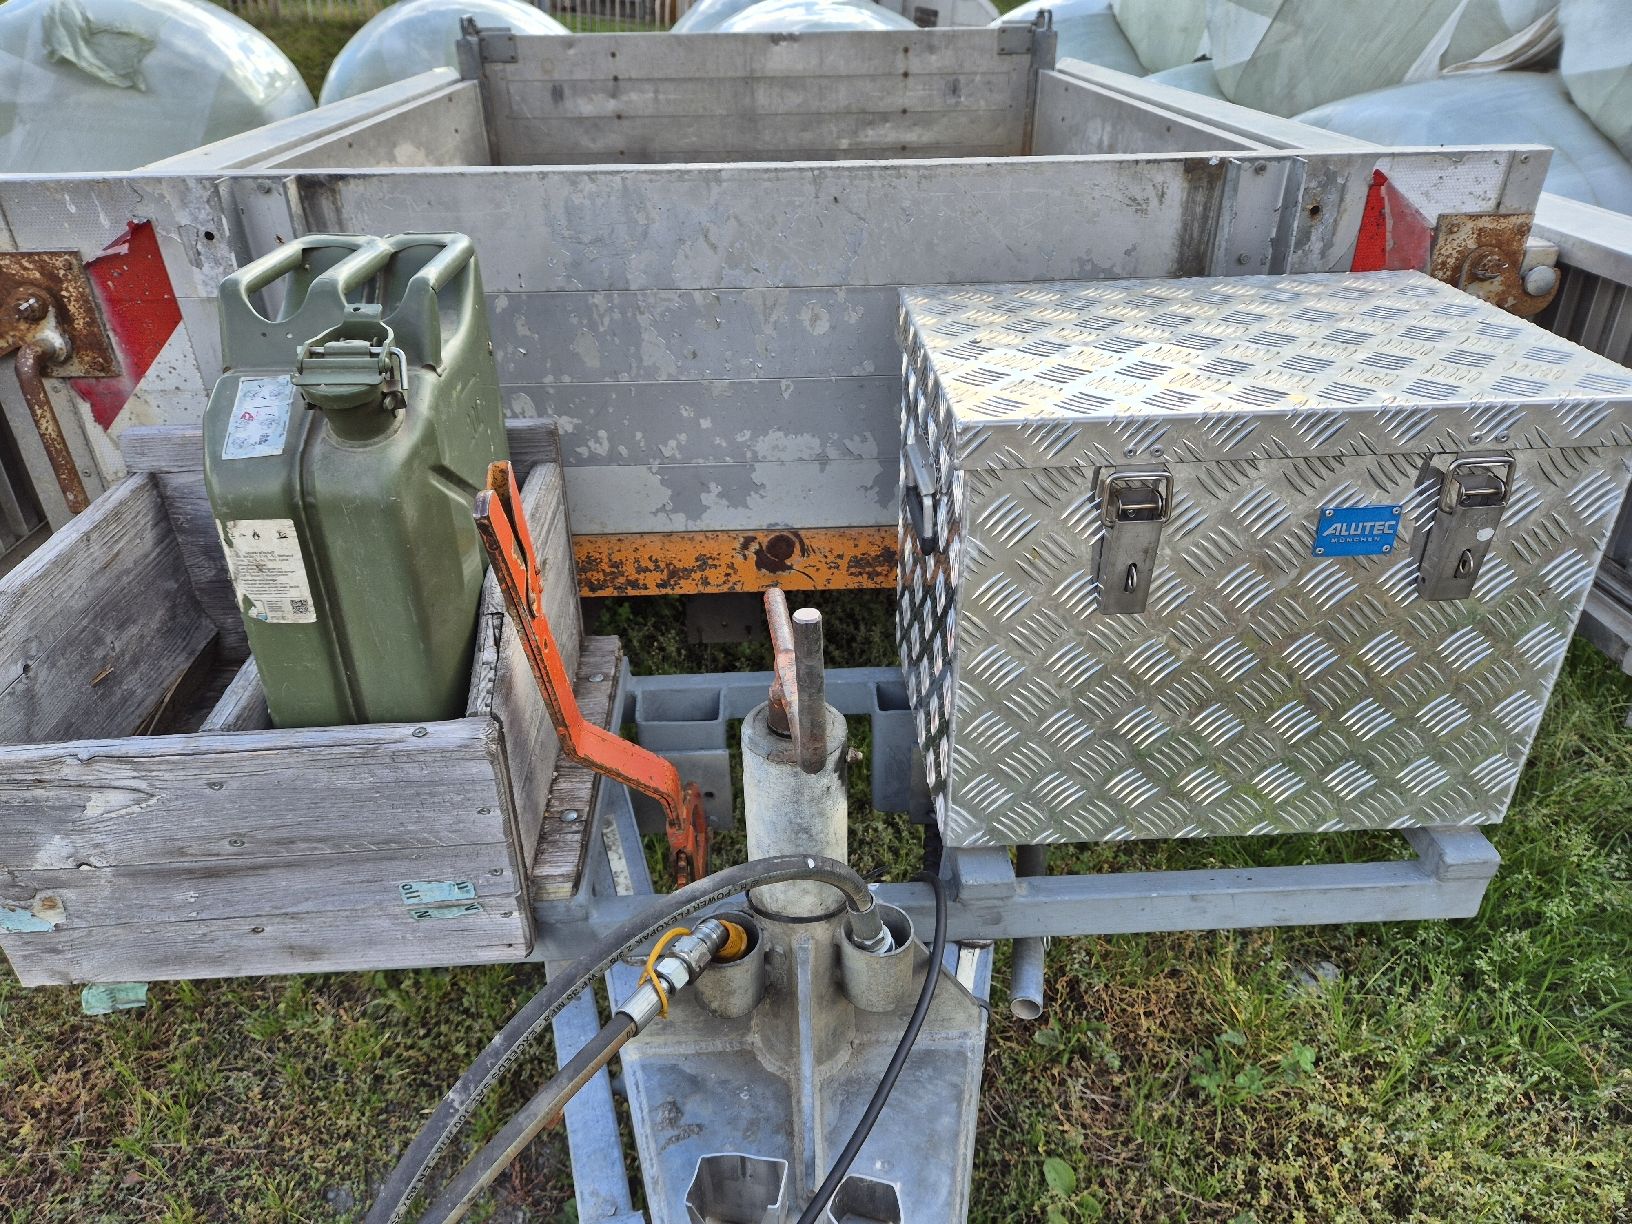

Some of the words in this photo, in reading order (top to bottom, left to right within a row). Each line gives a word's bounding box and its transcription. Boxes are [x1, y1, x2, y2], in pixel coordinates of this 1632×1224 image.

[1322, 520, 1397, 537] ALUTEC
[693, 891, 731, 911] POWER
[635, 908, 691, 945] FLEXOPAK
[581, 973, 598, 990] WP
[566, 988, 580, 1001] 35
[492, 1028, 537, 1080] EXCEEDS
